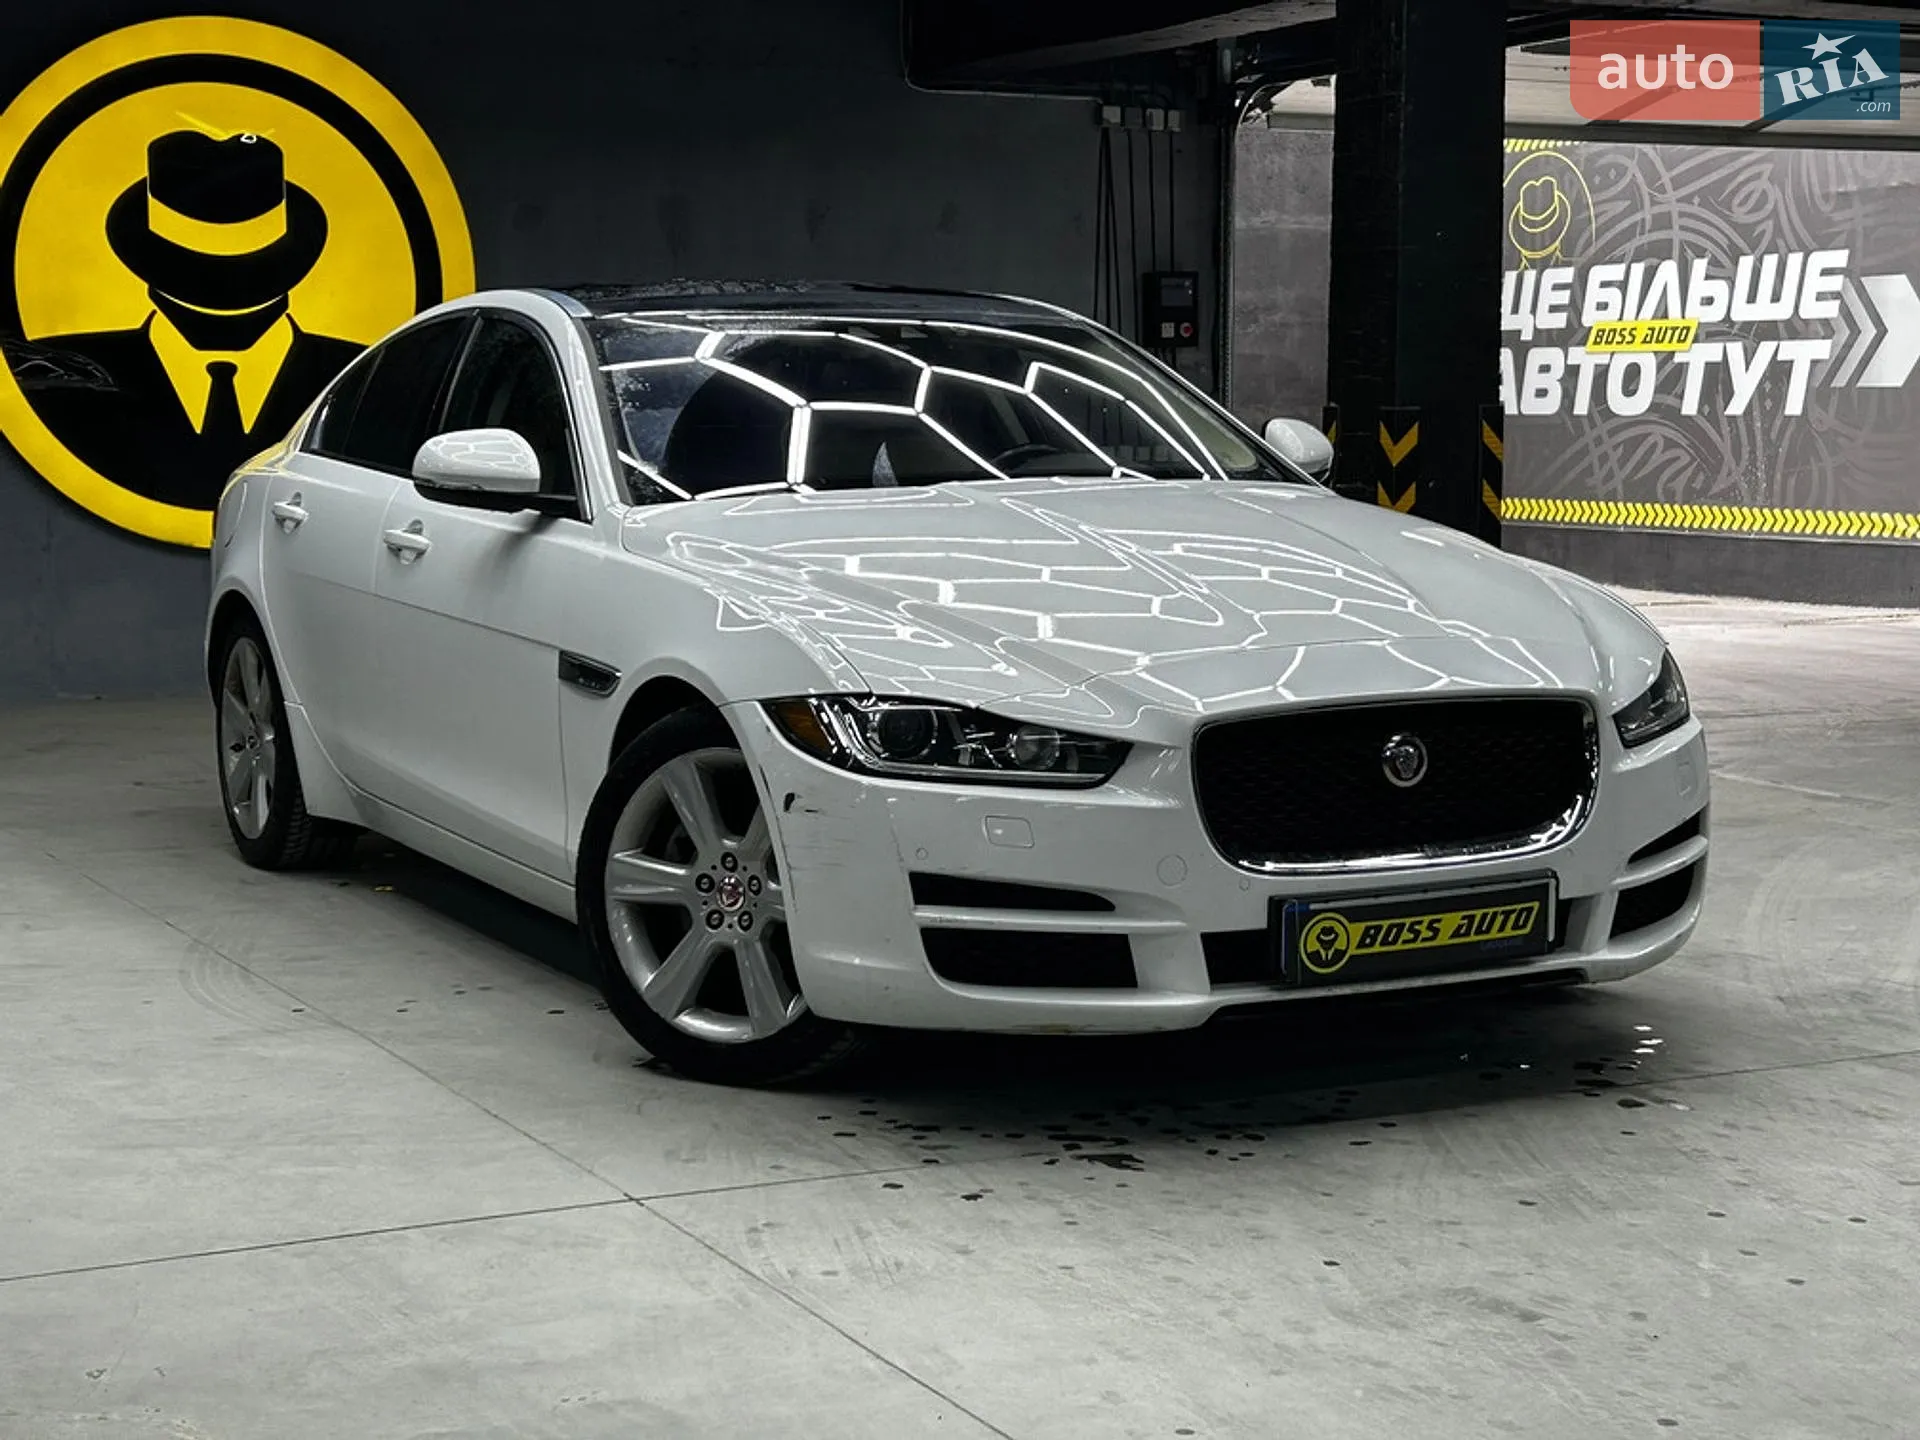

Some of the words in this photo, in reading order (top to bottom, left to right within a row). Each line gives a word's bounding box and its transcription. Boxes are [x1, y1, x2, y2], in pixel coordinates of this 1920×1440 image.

[1582, 249, 1850, 327] БІЛЬШЕ
[1592, 327, 1637, 346] BOSS
[1640, 325, 1692, 344] AUTO
[1674, 339, 1833, 416] ТУТ
[1356, 917, 1441, 950] BOSS
[1449, 905, 1535, 939] AUTO
